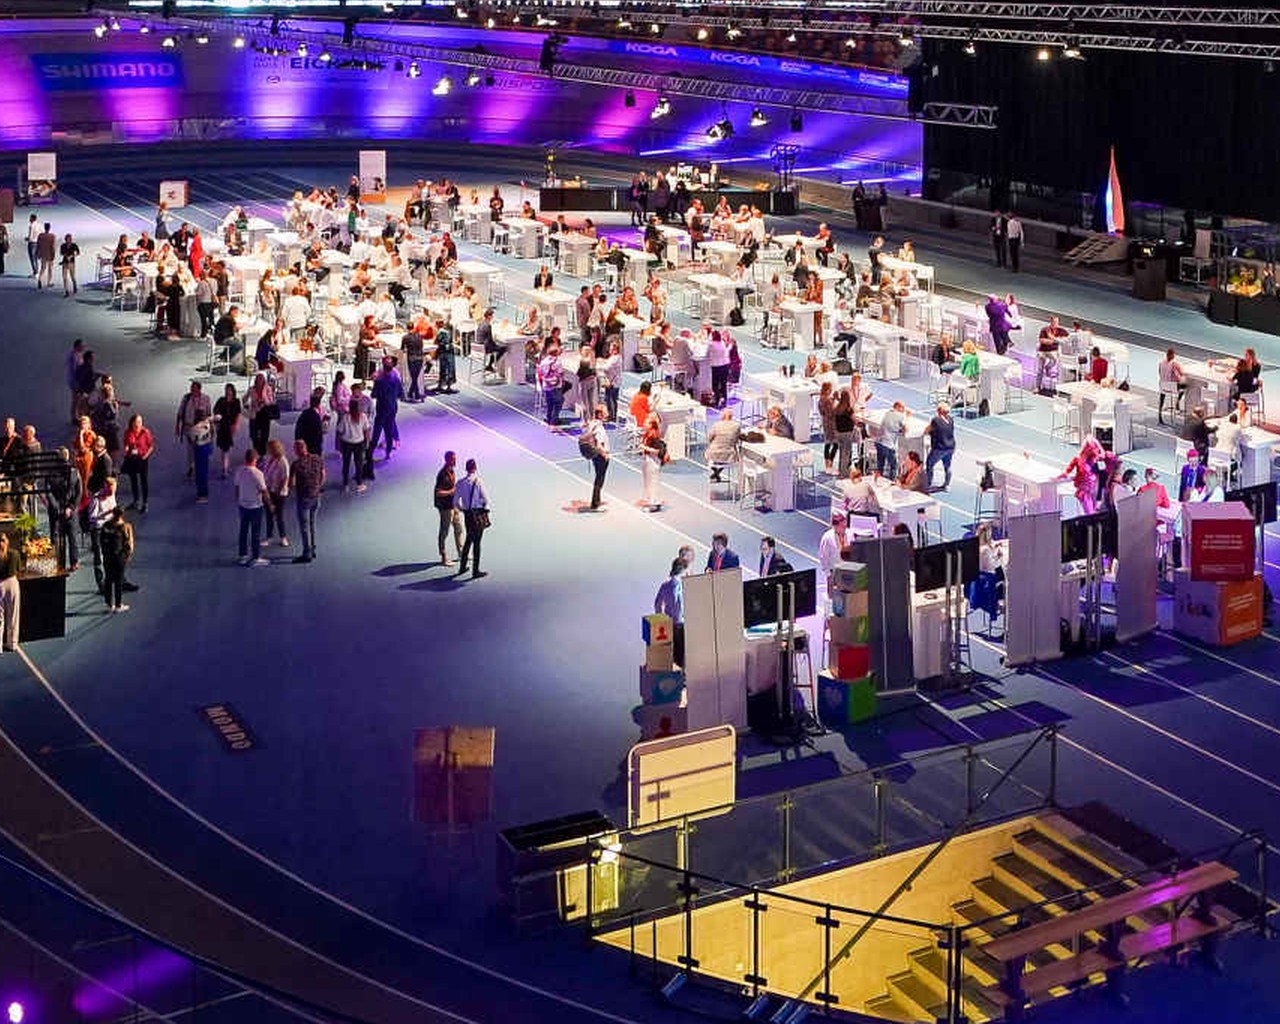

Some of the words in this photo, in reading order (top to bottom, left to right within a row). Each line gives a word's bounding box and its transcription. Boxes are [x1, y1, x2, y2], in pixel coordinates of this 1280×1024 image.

[626, 43, 678, 56] KOGA
[710, 52, 761, 67] KOGA
[41, 62, 175, 78] SHIMANO
[204, 706, 253, 749] MONDO
